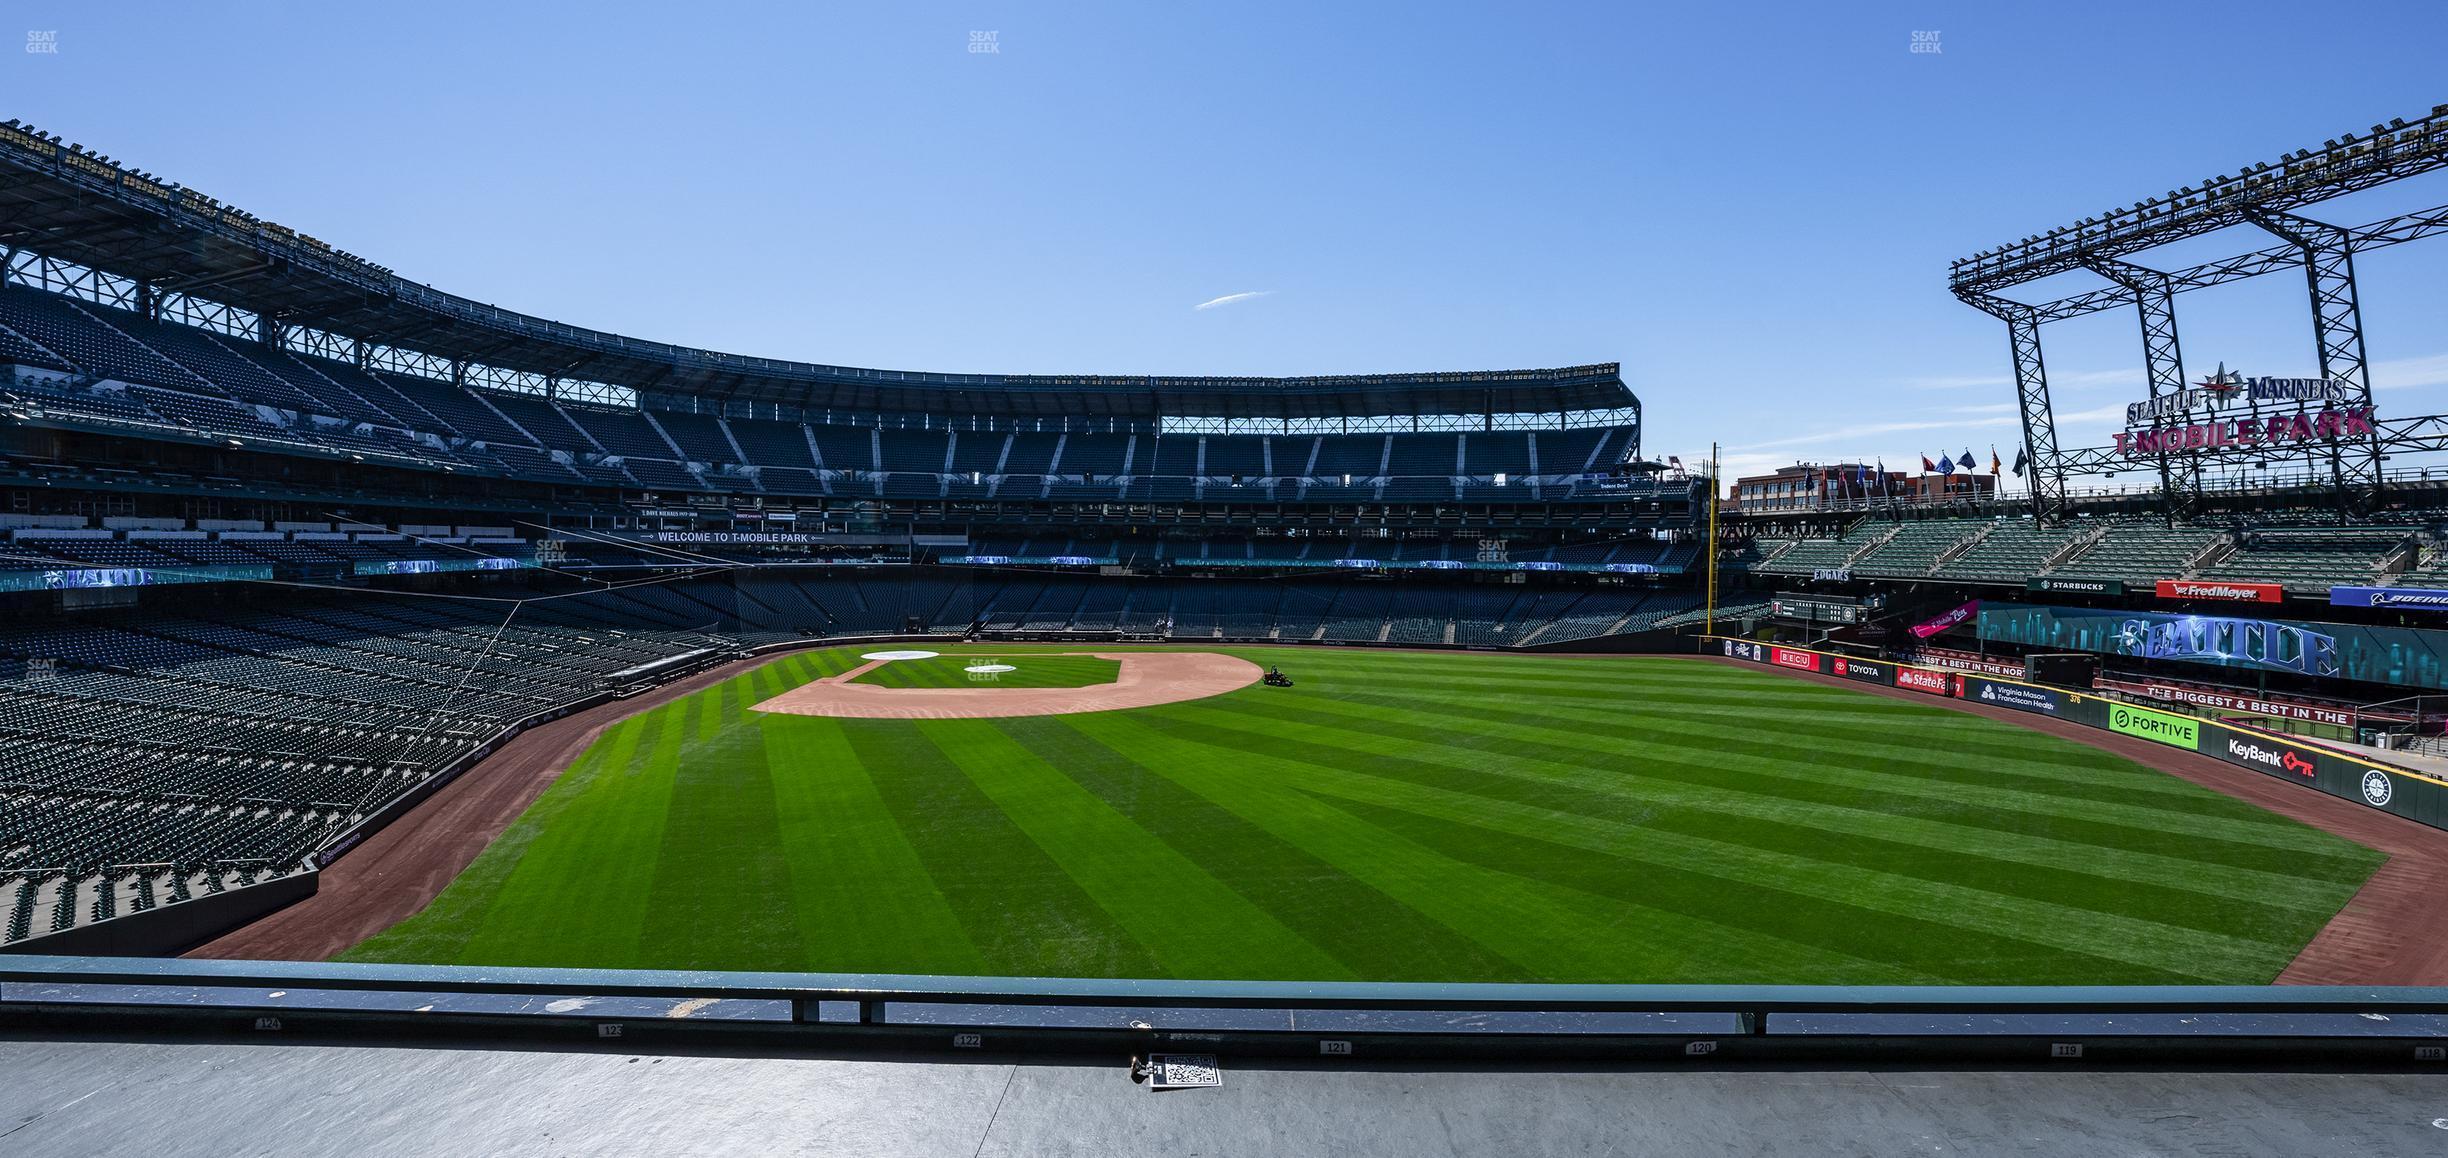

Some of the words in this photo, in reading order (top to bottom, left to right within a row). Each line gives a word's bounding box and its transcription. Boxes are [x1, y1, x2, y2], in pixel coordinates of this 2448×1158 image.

[2127, 388, 2202, 424] SEATTLE
[2246, 376, 2346, 400] MARINERS
[2112, 416, 2260, 455] T-MOBILE
[2267, 405, 2379, 443] PARK
[657, 532, 711, 543] WELCOME
[713, 532, 728, 543] TO
[732, 533, 779, 543] T-MOBILE
[780, 534, 808, 543] PARK
[2053, 582, 2103, 591] STARBUCKS
[1782, 653, 1807, 665] BECU
[1848, 664, 1879, 676] TOYOTA
[1949, 660, 1971, 670] BEST
[1971, 663, 1981, 671] IN
[1983, 664, 2001, 674] THE
[1997, 686, 2022, 697] Virginia
[2023, 690, 2046, 700] Mason
[2069, 694, 2081, 704] 376
[1997, 695, 2032, 706] Franciscan
[2033, 699, 2054, 710] Health
[2147, 687, 2171, 698] THE
[2175, 692, 2233, 708] BIGGEST
[2236, 700, 2246, 709] &
[2251, 702, 2289, 716] BEST
[2293, 707, 2309, 718] IN
[2314, 711, 2347, 724] THE
[2132, 716, 2193, 740] FORTIVE
[2228, 738, 2282, 768] KeyBank
[605, 1025, 623, 1035] 123
[961, 1036, 978, 1045] 122
[1328, 1043, 1346, 1052] 121
[1692, 1043, 1711, 1053] 120
[2060, 1046, 2076, 1055] 119
[2423, 1049, 2440, 1057] 118
